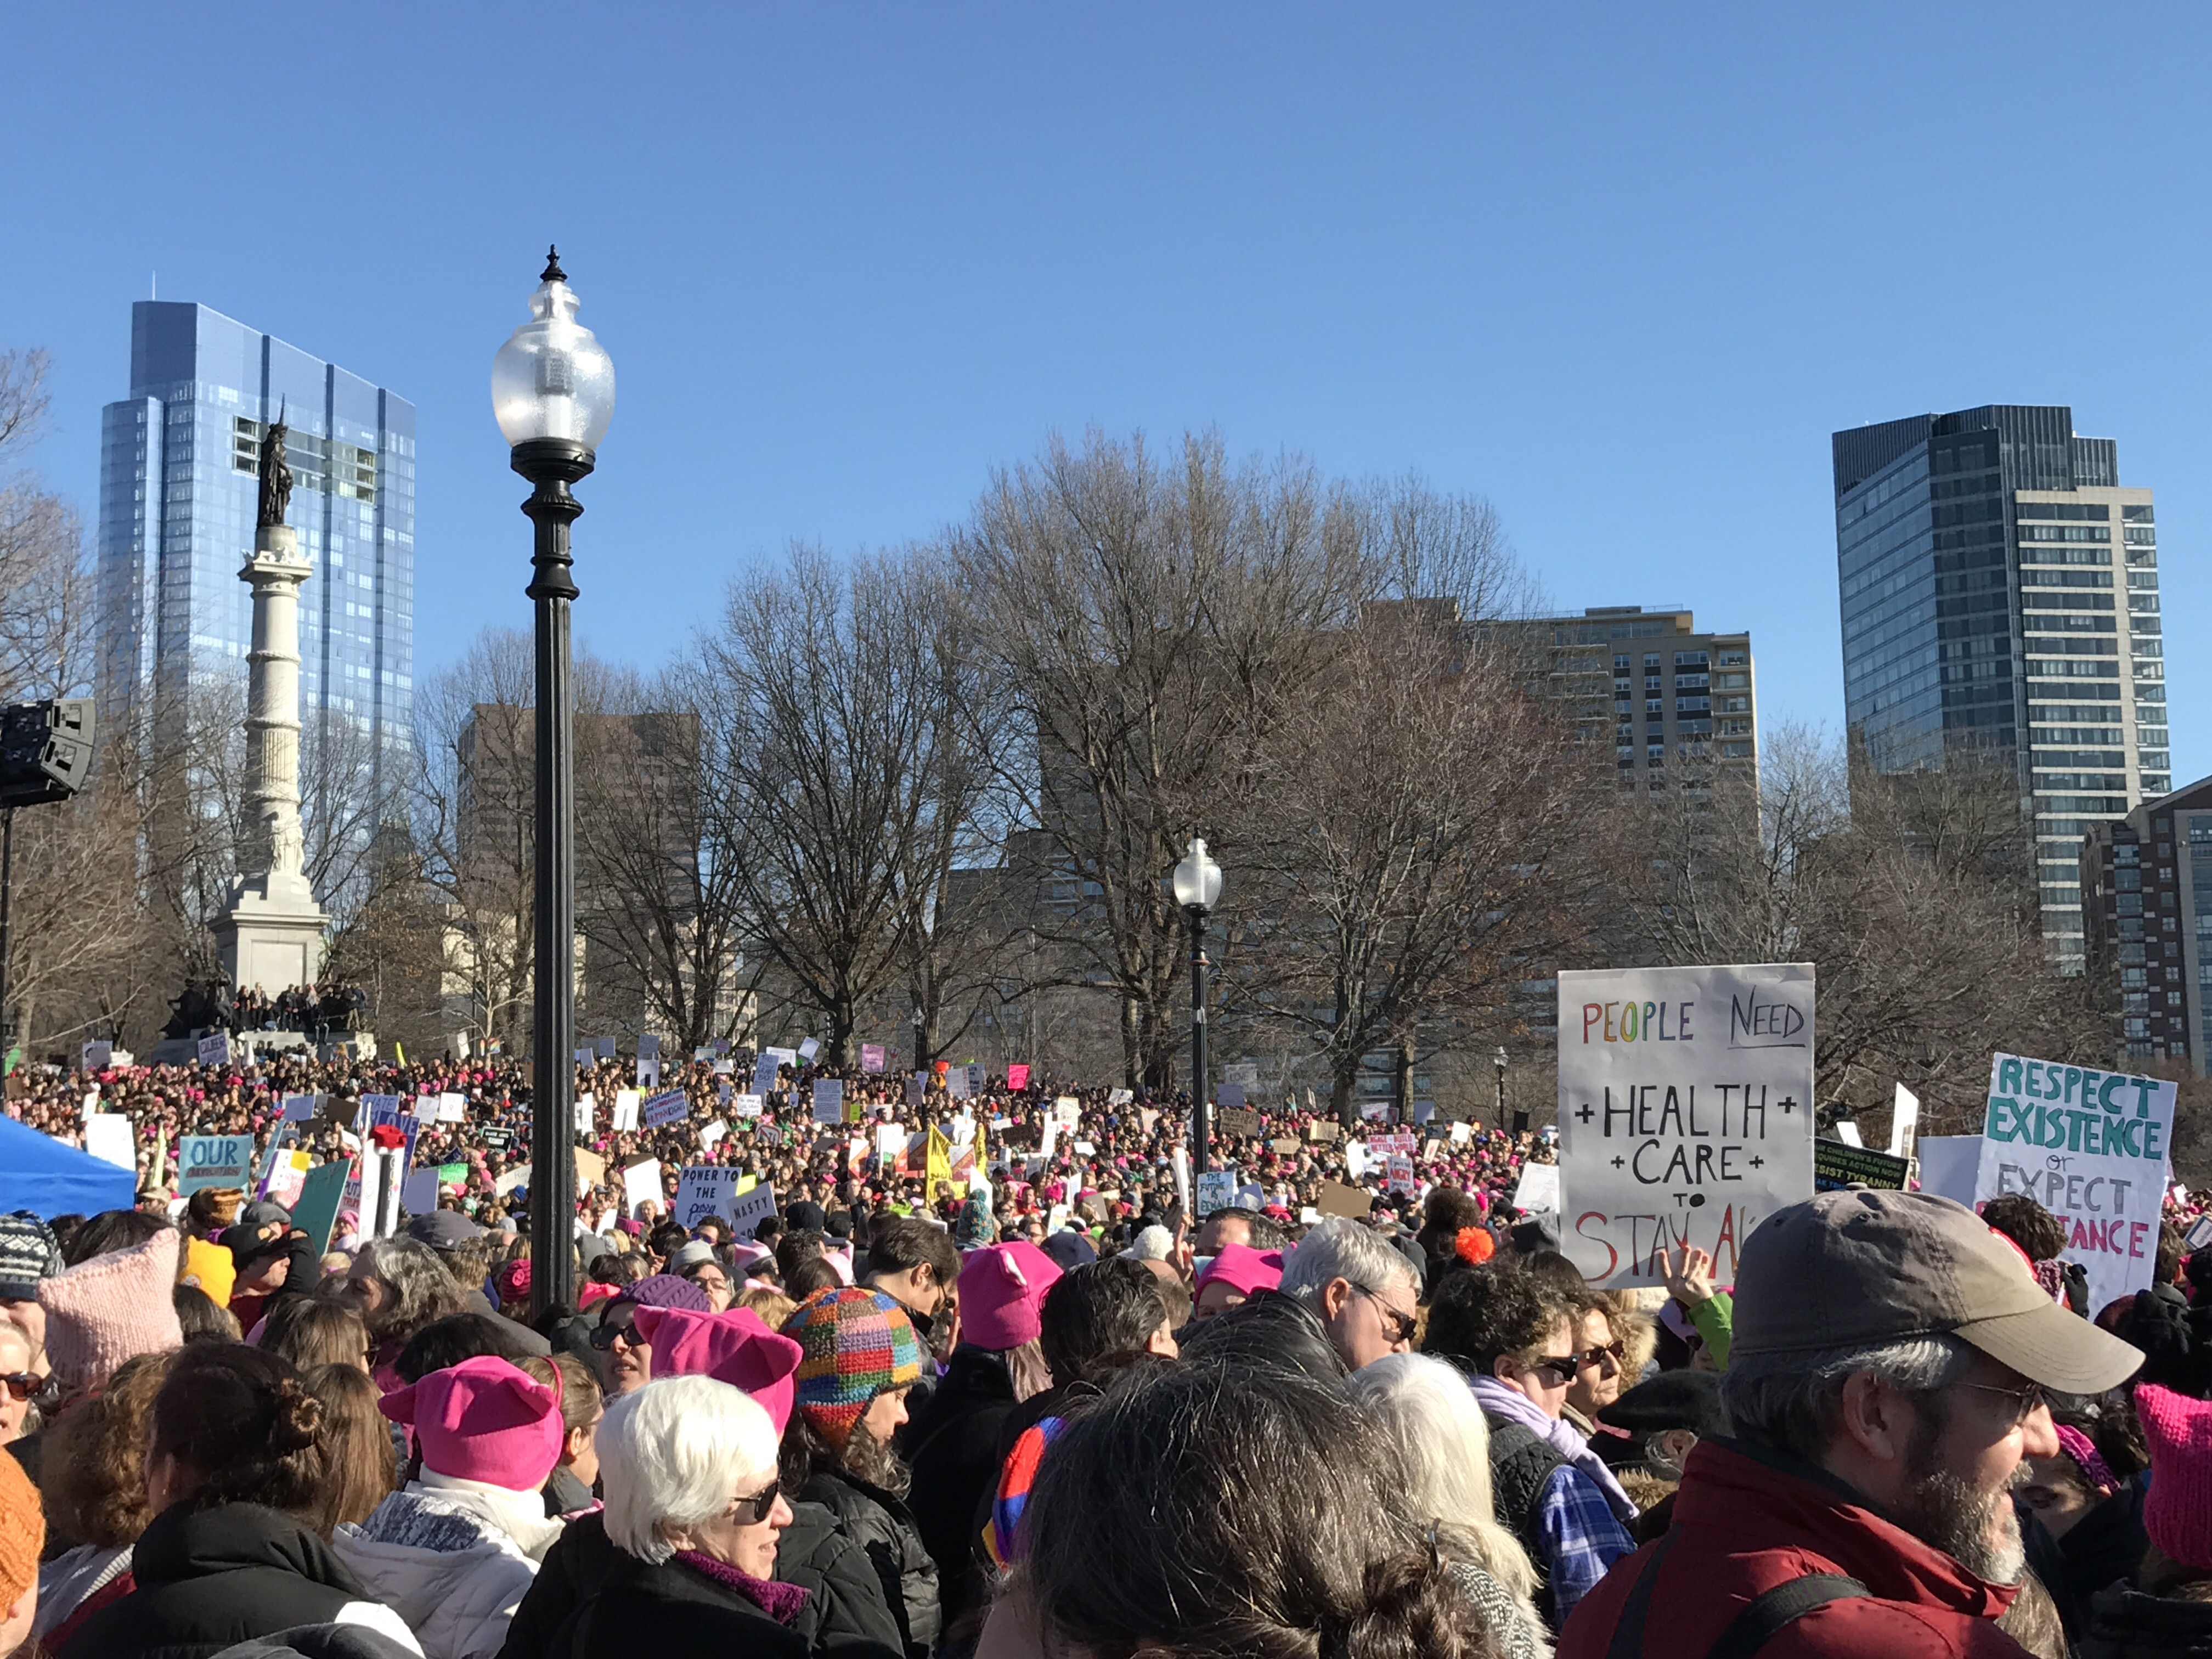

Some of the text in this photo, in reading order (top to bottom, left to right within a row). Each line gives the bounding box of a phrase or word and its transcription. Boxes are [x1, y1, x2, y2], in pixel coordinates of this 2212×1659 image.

[1583, 985, 1804, 1045] PEOPLE NEED
[1229, 1071, 1250, 1081] LOVE
[1999, 1058, 2160, 1119] RESPECT
[364, 1097, 394, 1110] HATE
[1604, 1084, 1767, 1139] HEALTH
[1224, 1116, 1253, 1125] MATTER
[1987, 1096, 2162, 1161] EXISTENCE
[191, 1140, 238, 1166] OUR
[1393, 1143, 1414, 1152] WORLD
[1826, 1147, 1872, 1161] CHILDREN'S
[1872, 1157, 1904, 1169] FUTURE
[1632, 1138, 1743, 1184] CARE
[1815, 1152, 1902, 1178] QUIRES ACTION NOW
[2045, 1154, 2075, 1172] or
[682, 1169, 739, 1186] POWER TO
[1206, 1172, 1221, 1181] THE
[1389, 1167, 1410, 1182] ANGRY
[1814, 1163, 1899, 1189] ESIST TYRANNY
[696, 1187, 717, 1199] THE
[1673, 1193, 1706, 1207] TO
[1997, 1163, 2132, 1215] EXPECT
[733, 1196, 768, 1221] NASTY
[1575, 1211, 1691, 1282] STAY
